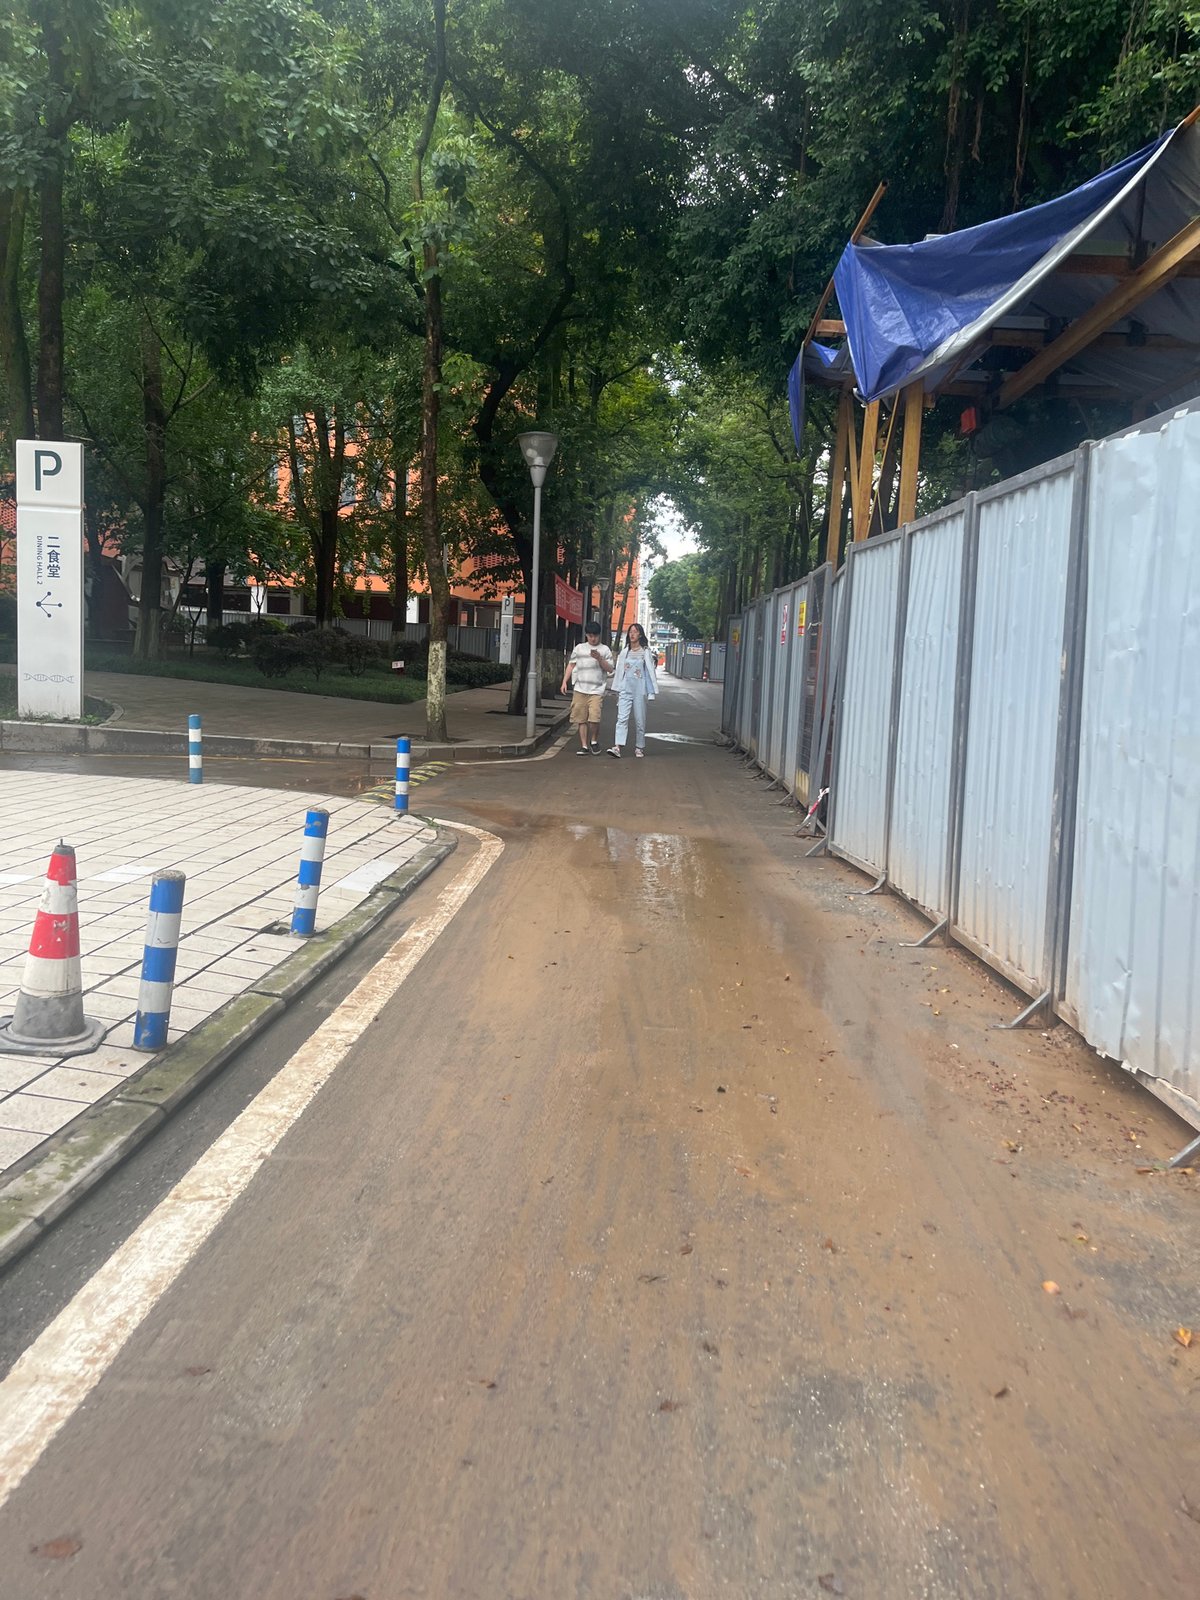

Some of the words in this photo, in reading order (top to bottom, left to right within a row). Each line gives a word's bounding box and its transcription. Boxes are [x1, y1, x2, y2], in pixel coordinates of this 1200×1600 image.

[34, 449, 63, 491] P
[46, 535, 61, 579] 二食堂
[505, 598, 511, 611] P
